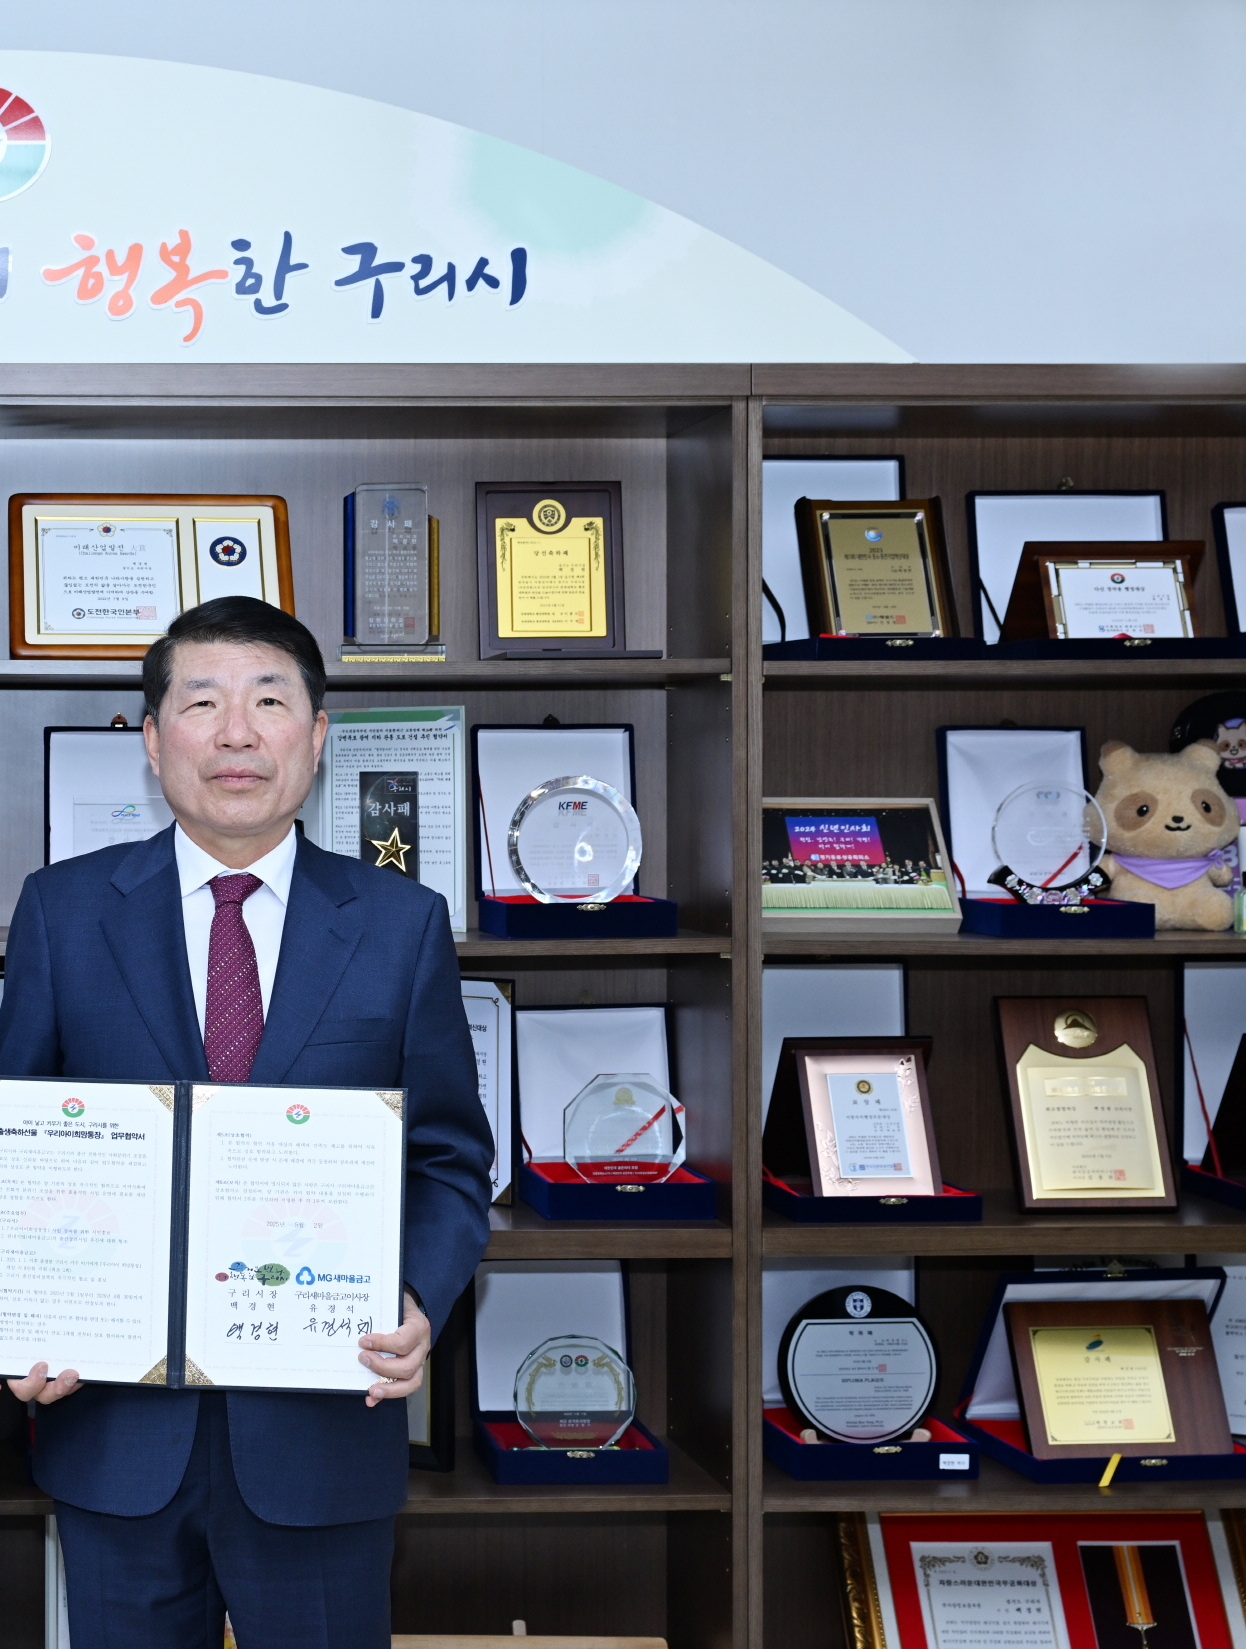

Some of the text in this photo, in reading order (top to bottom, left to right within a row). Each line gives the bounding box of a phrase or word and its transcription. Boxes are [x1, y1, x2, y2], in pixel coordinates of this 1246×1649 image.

[43, 227, 309, 343] 행복한
[335, 240, 526, 319] 구리시
[371, 520, 412, 528] 감사패
[368, 802, 410, 816] 감사패
[558, 801, 588, 810] KFME
[820, 824, 870, 832] 신년인사회
[111, 1132, 145, 1140] 업무협약서
[318, 1274, 371, 1283] MG 새마을금고
[295, 1291, 369, 1301] 구리새마을금고이사장
